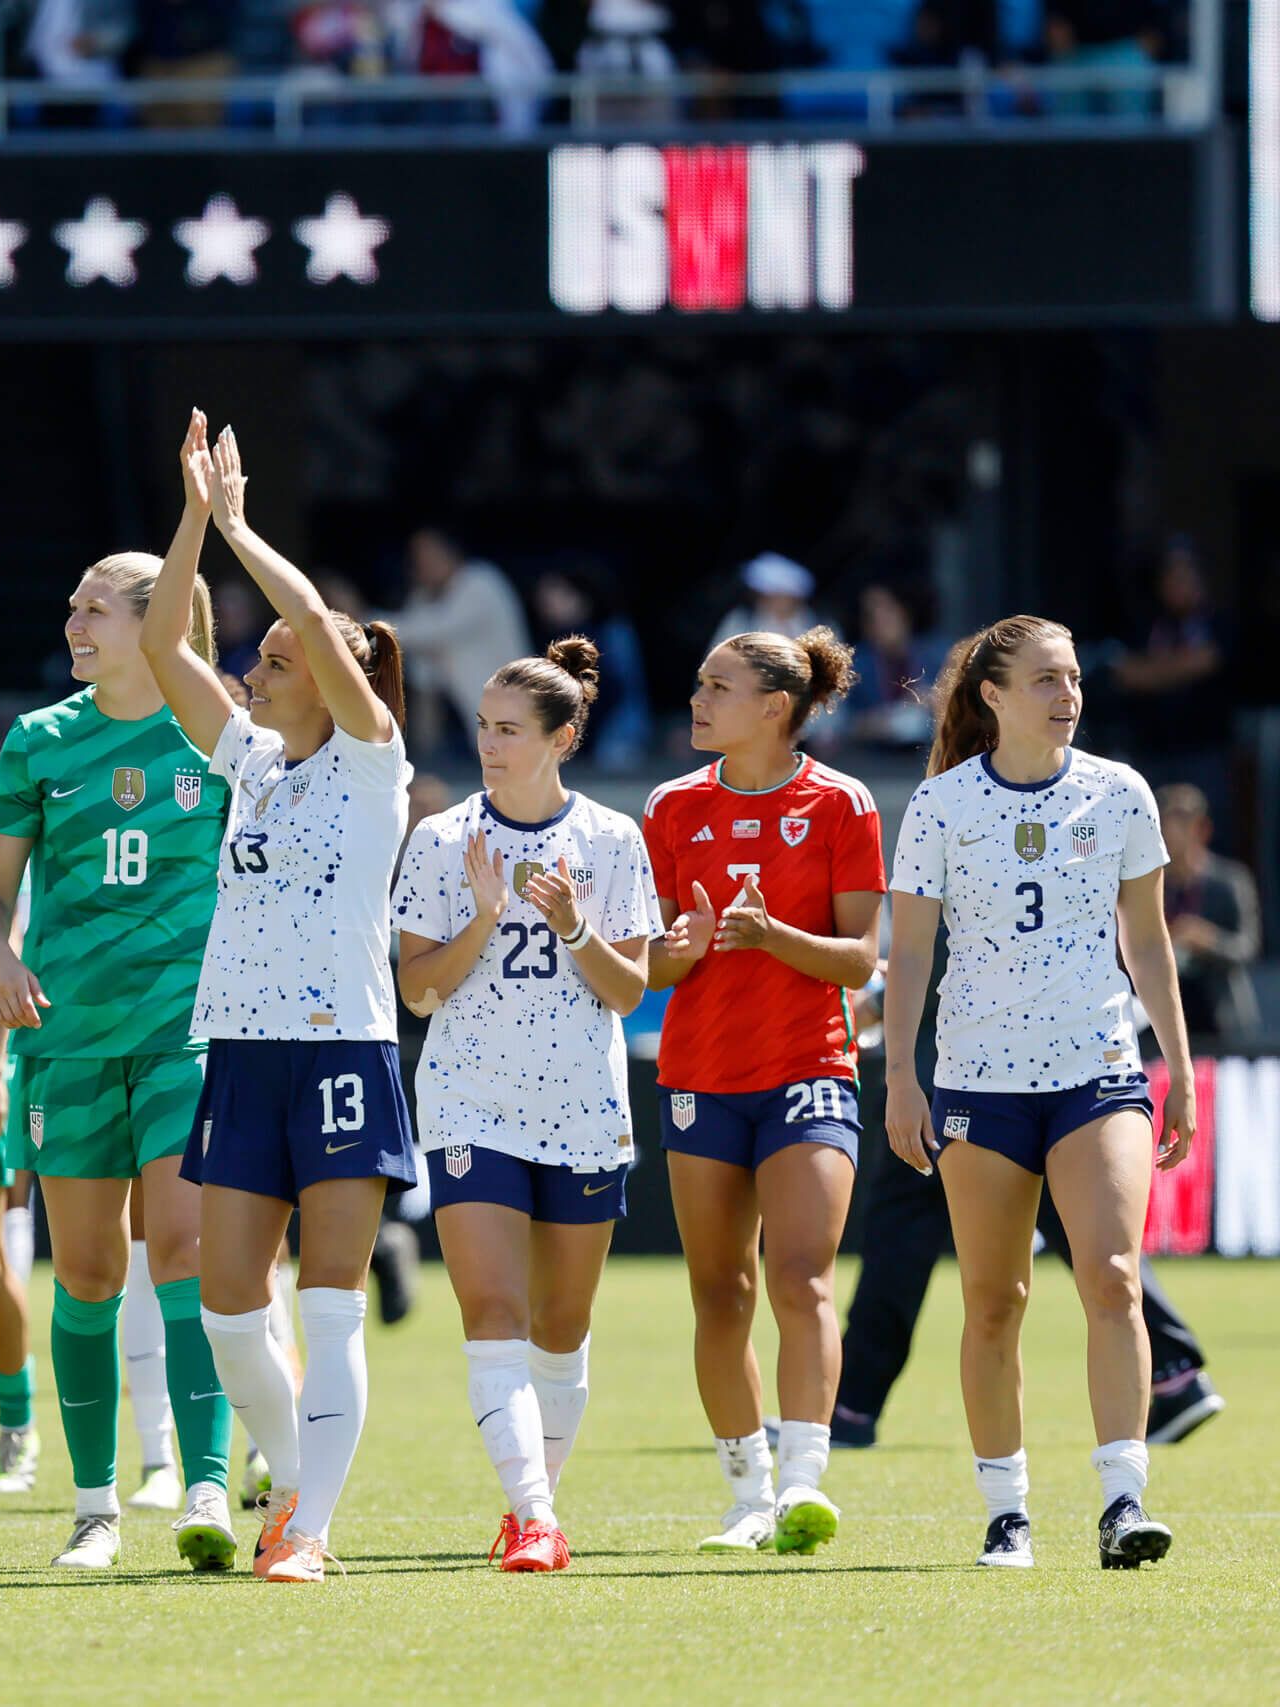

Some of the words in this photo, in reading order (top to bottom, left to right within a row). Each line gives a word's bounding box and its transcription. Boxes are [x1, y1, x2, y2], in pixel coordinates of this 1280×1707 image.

[548, 142, 864, 313] USWNT
[176, 777, 200, 792] USA
[292, 780, 310, 795] US
[230, 828, 269, 874] 13
[1072, 826, 1095, 840] USA
[102, 828, 148, 885] 18
[569, 868, 593, 883] USA
[726, 863, 760, 908] 7
[1015, 881, 1043, 933] 3
[501, 922, 558, 979] 23
[319, 1073, 365, 1134] 13
[672, 1096, 694, 1109] USA
[785, 1079, 843, 1124] 20
[946, 1118, 967, 1132] USA
[446, 1144, 470, 1158] USA
